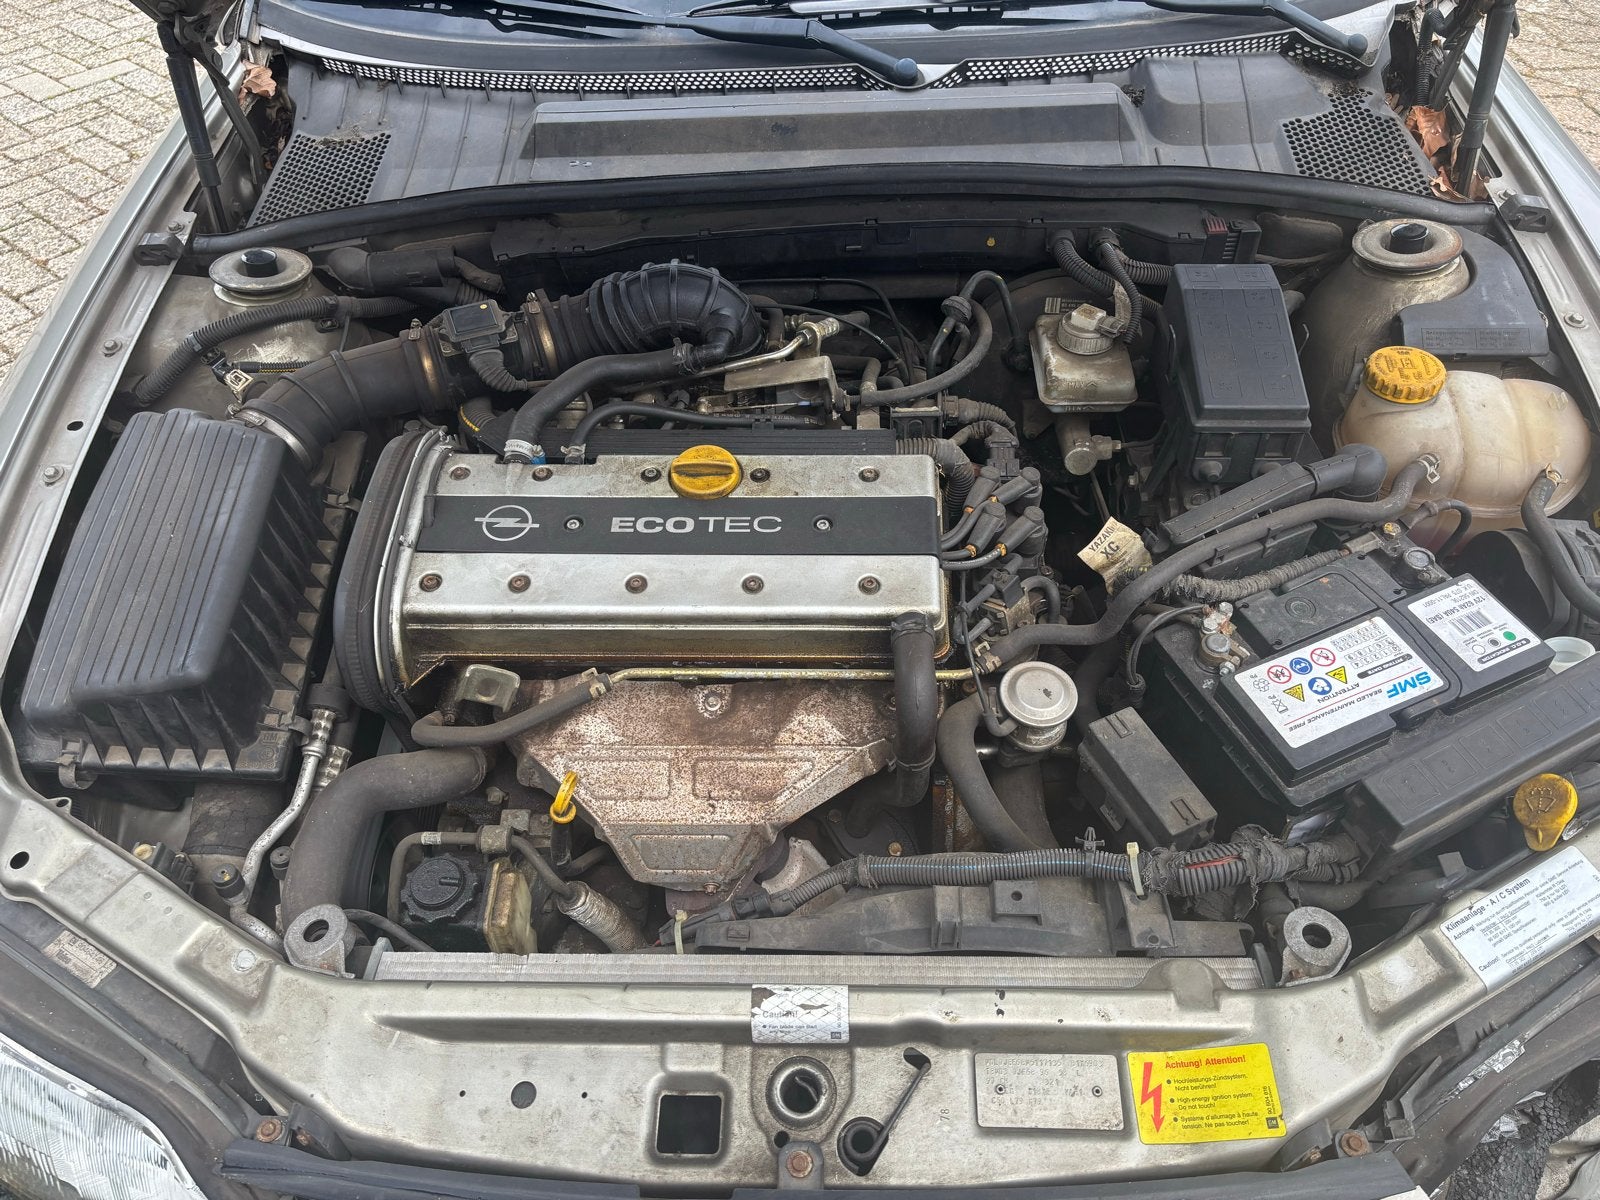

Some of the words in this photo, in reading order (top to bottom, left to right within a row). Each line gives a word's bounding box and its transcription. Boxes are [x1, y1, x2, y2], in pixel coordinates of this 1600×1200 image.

[610, 514, 783, 534] ECOTEC
[1100, 540, 1120, 560] XC
[1473, 595, 1486, 605] 12V
[1386, 671, 1432, 699] SMF
[1316, 682, 1360, 704] ATTENTION
[1356, 688, 1382, 702] SEALED
[1306, 700, 1356, 724] MAINTENANCE
[1288, 721, 1306, 732] FREE
[1445, 905, 1486, 932] Klimaanlage
[1505, 878, 1530, 896] System
[1453, 925, 1475, 940] Achtung!
[1478, 956, 1500, 972] Caution!
[762, 1010, 798, 1018] Cautn!
[1165, 1059, 1203, 1069] Achtung!
[1205, 1055, 1247, 1066] Attention!
[1190, 1082, 1217, 1091] berühren!
[1177, 1095, 1210, 1104] High-energy
[940, 1108, 950, 1121] 78
